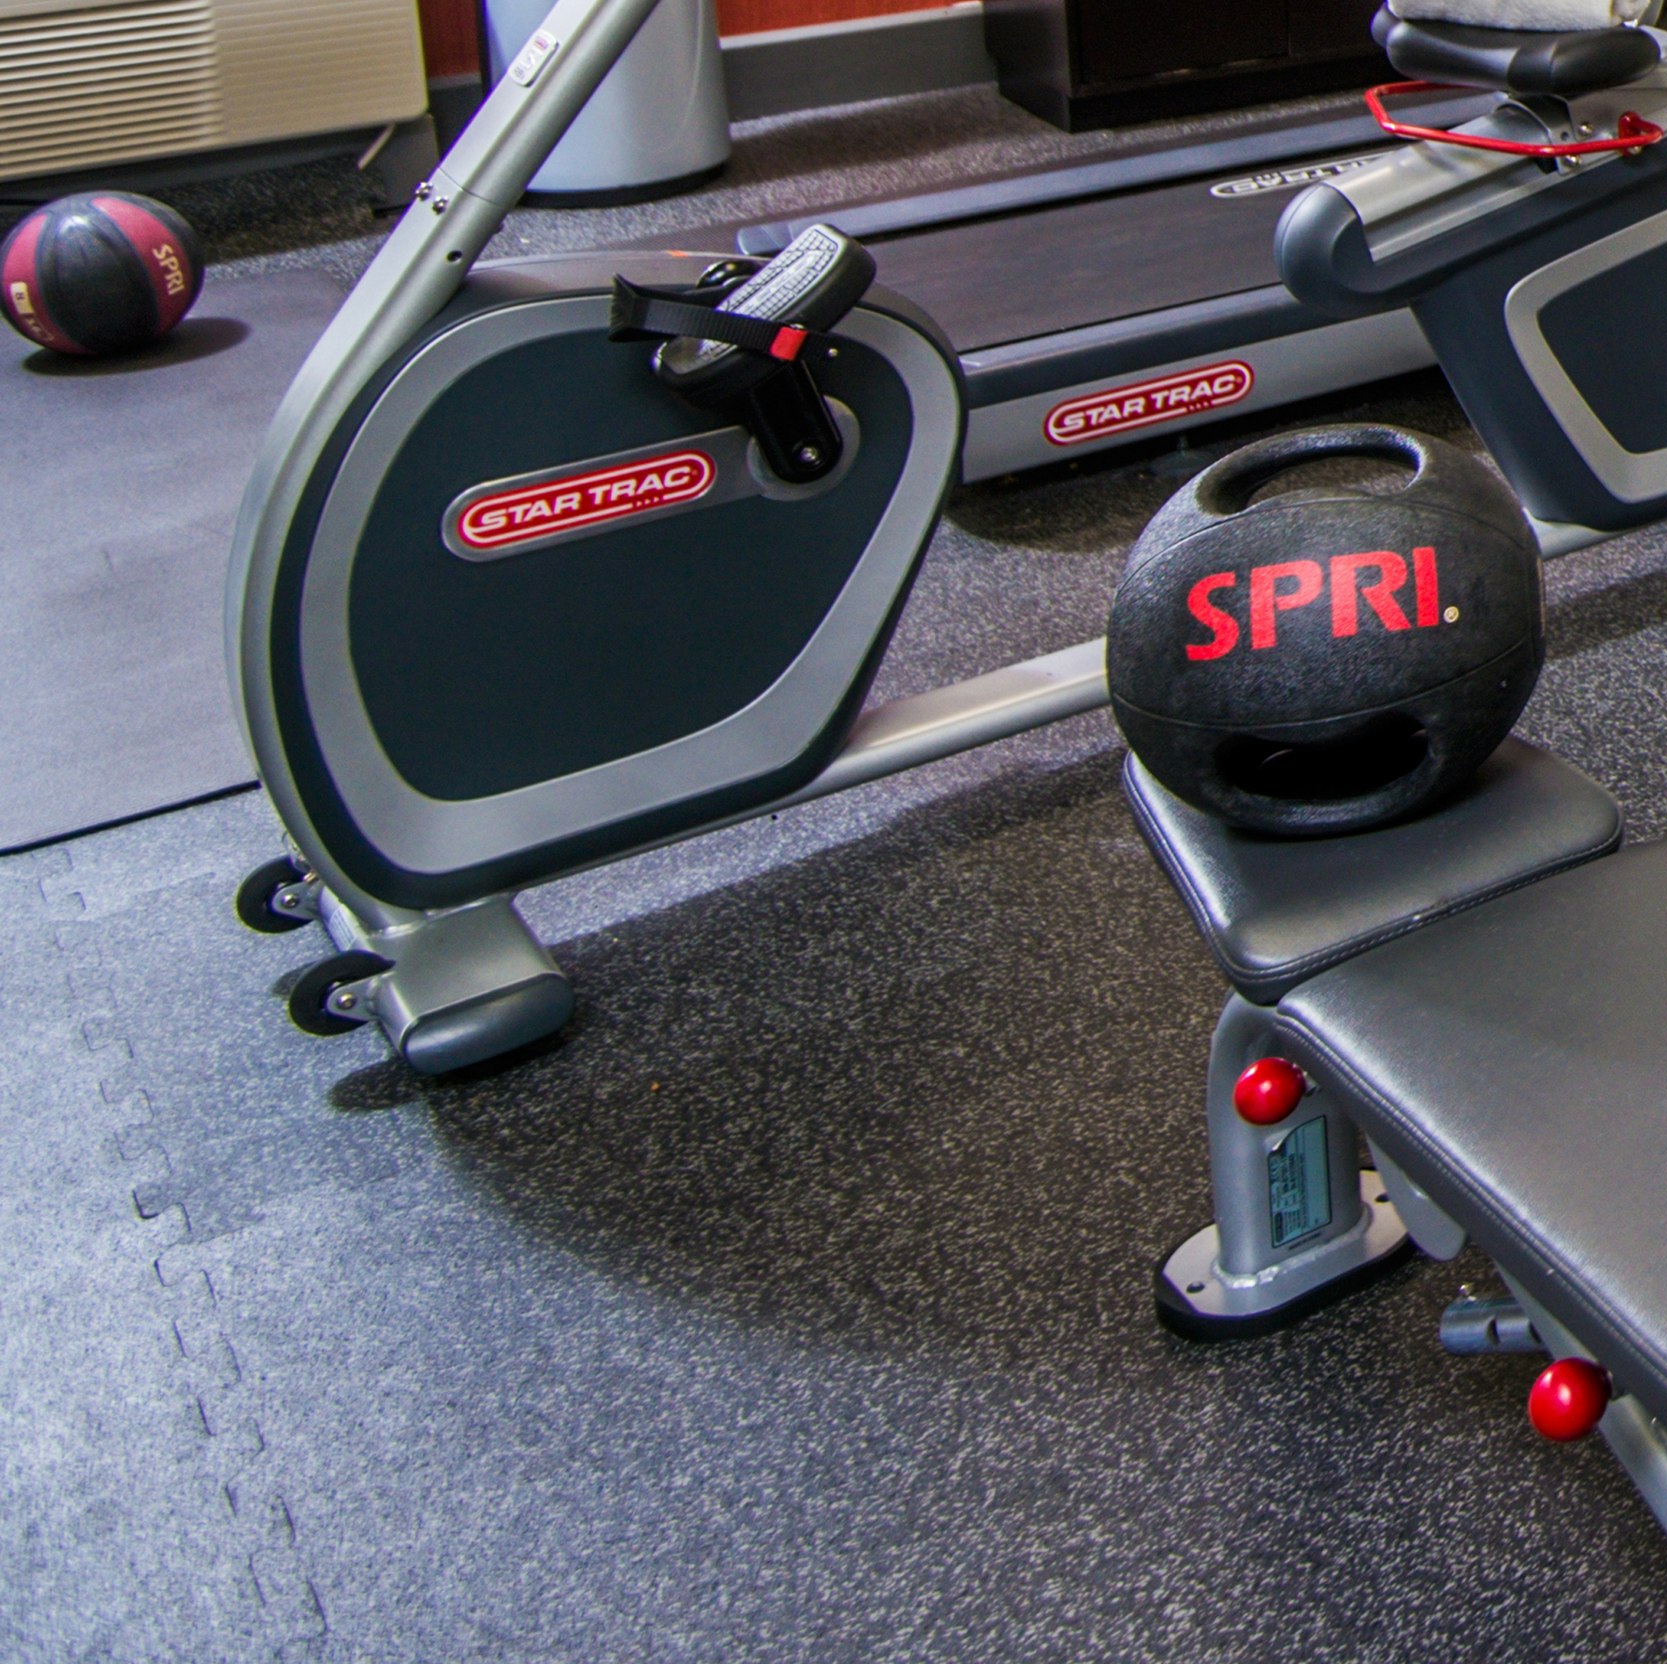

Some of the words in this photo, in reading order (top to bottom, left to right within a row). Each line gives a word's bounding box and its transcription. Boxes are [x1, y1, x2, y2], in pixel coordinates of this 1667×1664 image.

[153, 244, 184, 295] SPRI
[1063, 397, 1145, 430] STAR
[1151, 375, 1235, 410] TRAC
[481, 492, 582, 530] STAR
[589, 466, 692, 505] TRAC
[1185, 546, 1439, 661] SPRI
